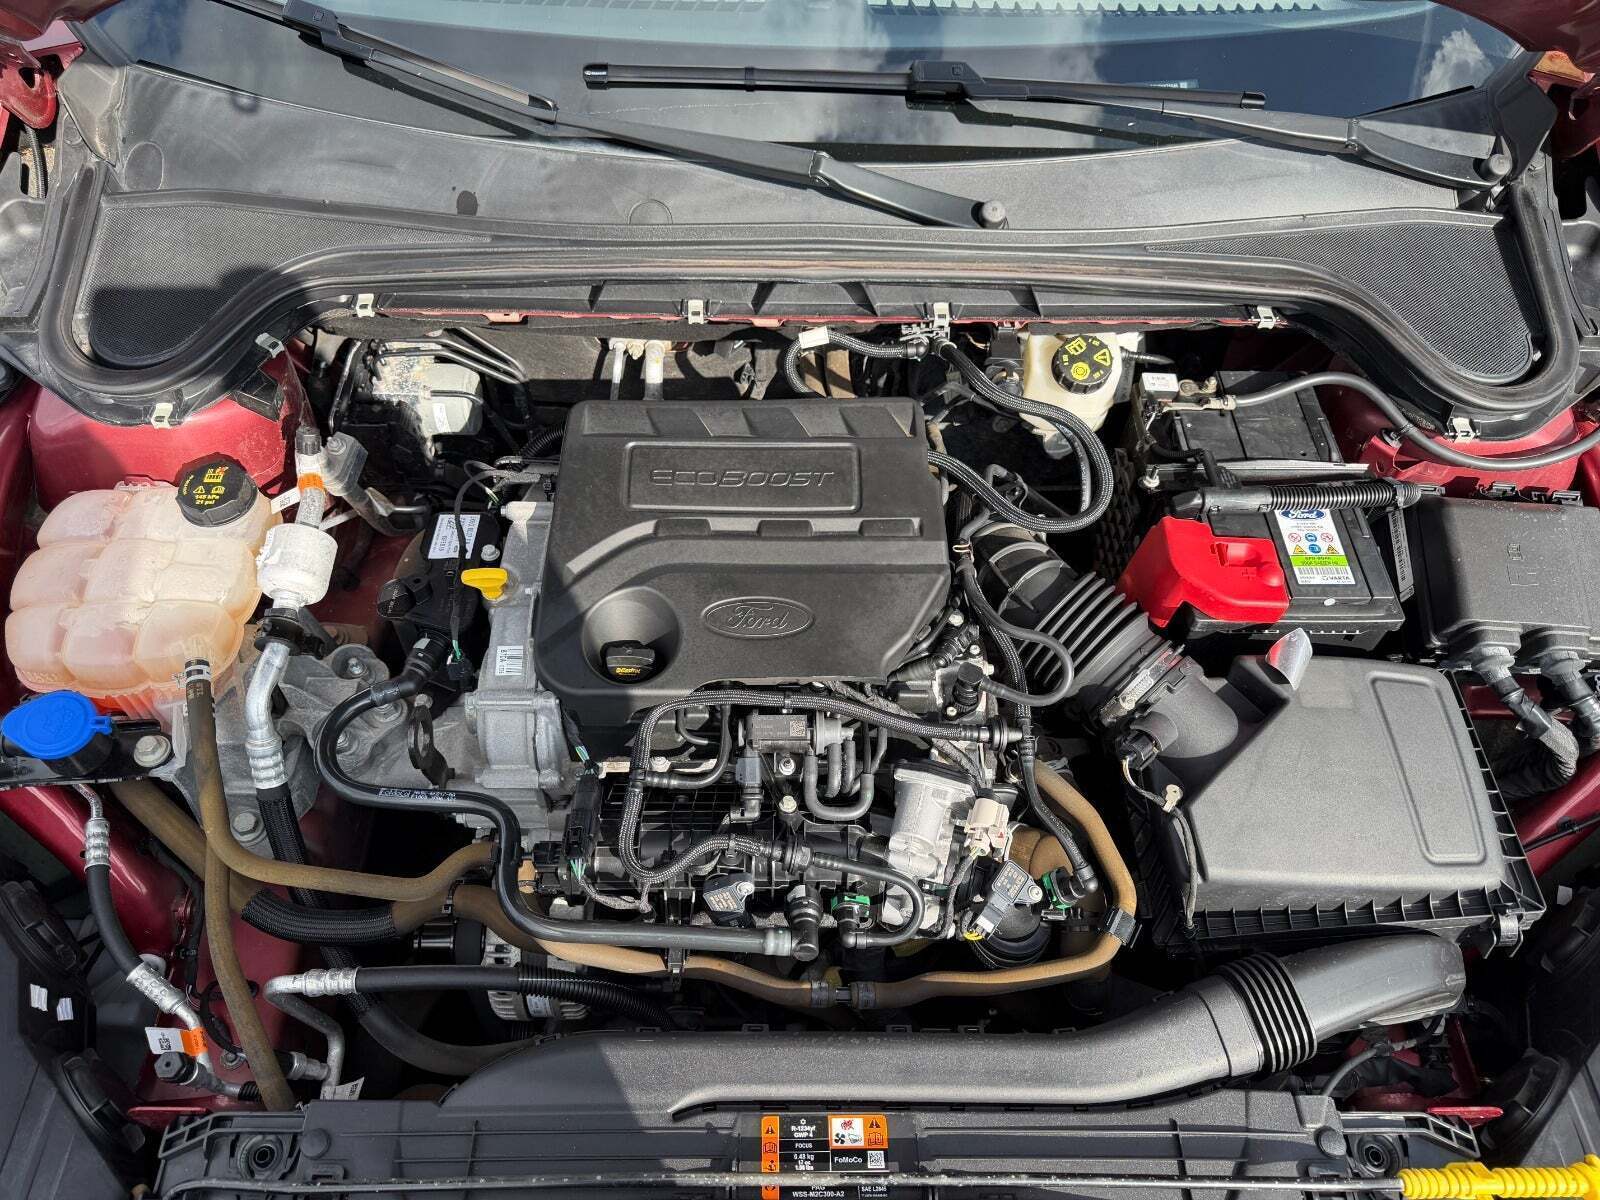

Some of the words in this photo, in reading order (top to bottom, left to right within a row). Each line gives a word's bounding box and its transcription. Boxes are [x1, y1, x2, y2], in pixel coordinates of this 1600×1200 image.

[727, 603, 788, 629] Ford
[791, 1125, 816, 1134] R-1234yf
[806, 1153, 815, 1161] kg
